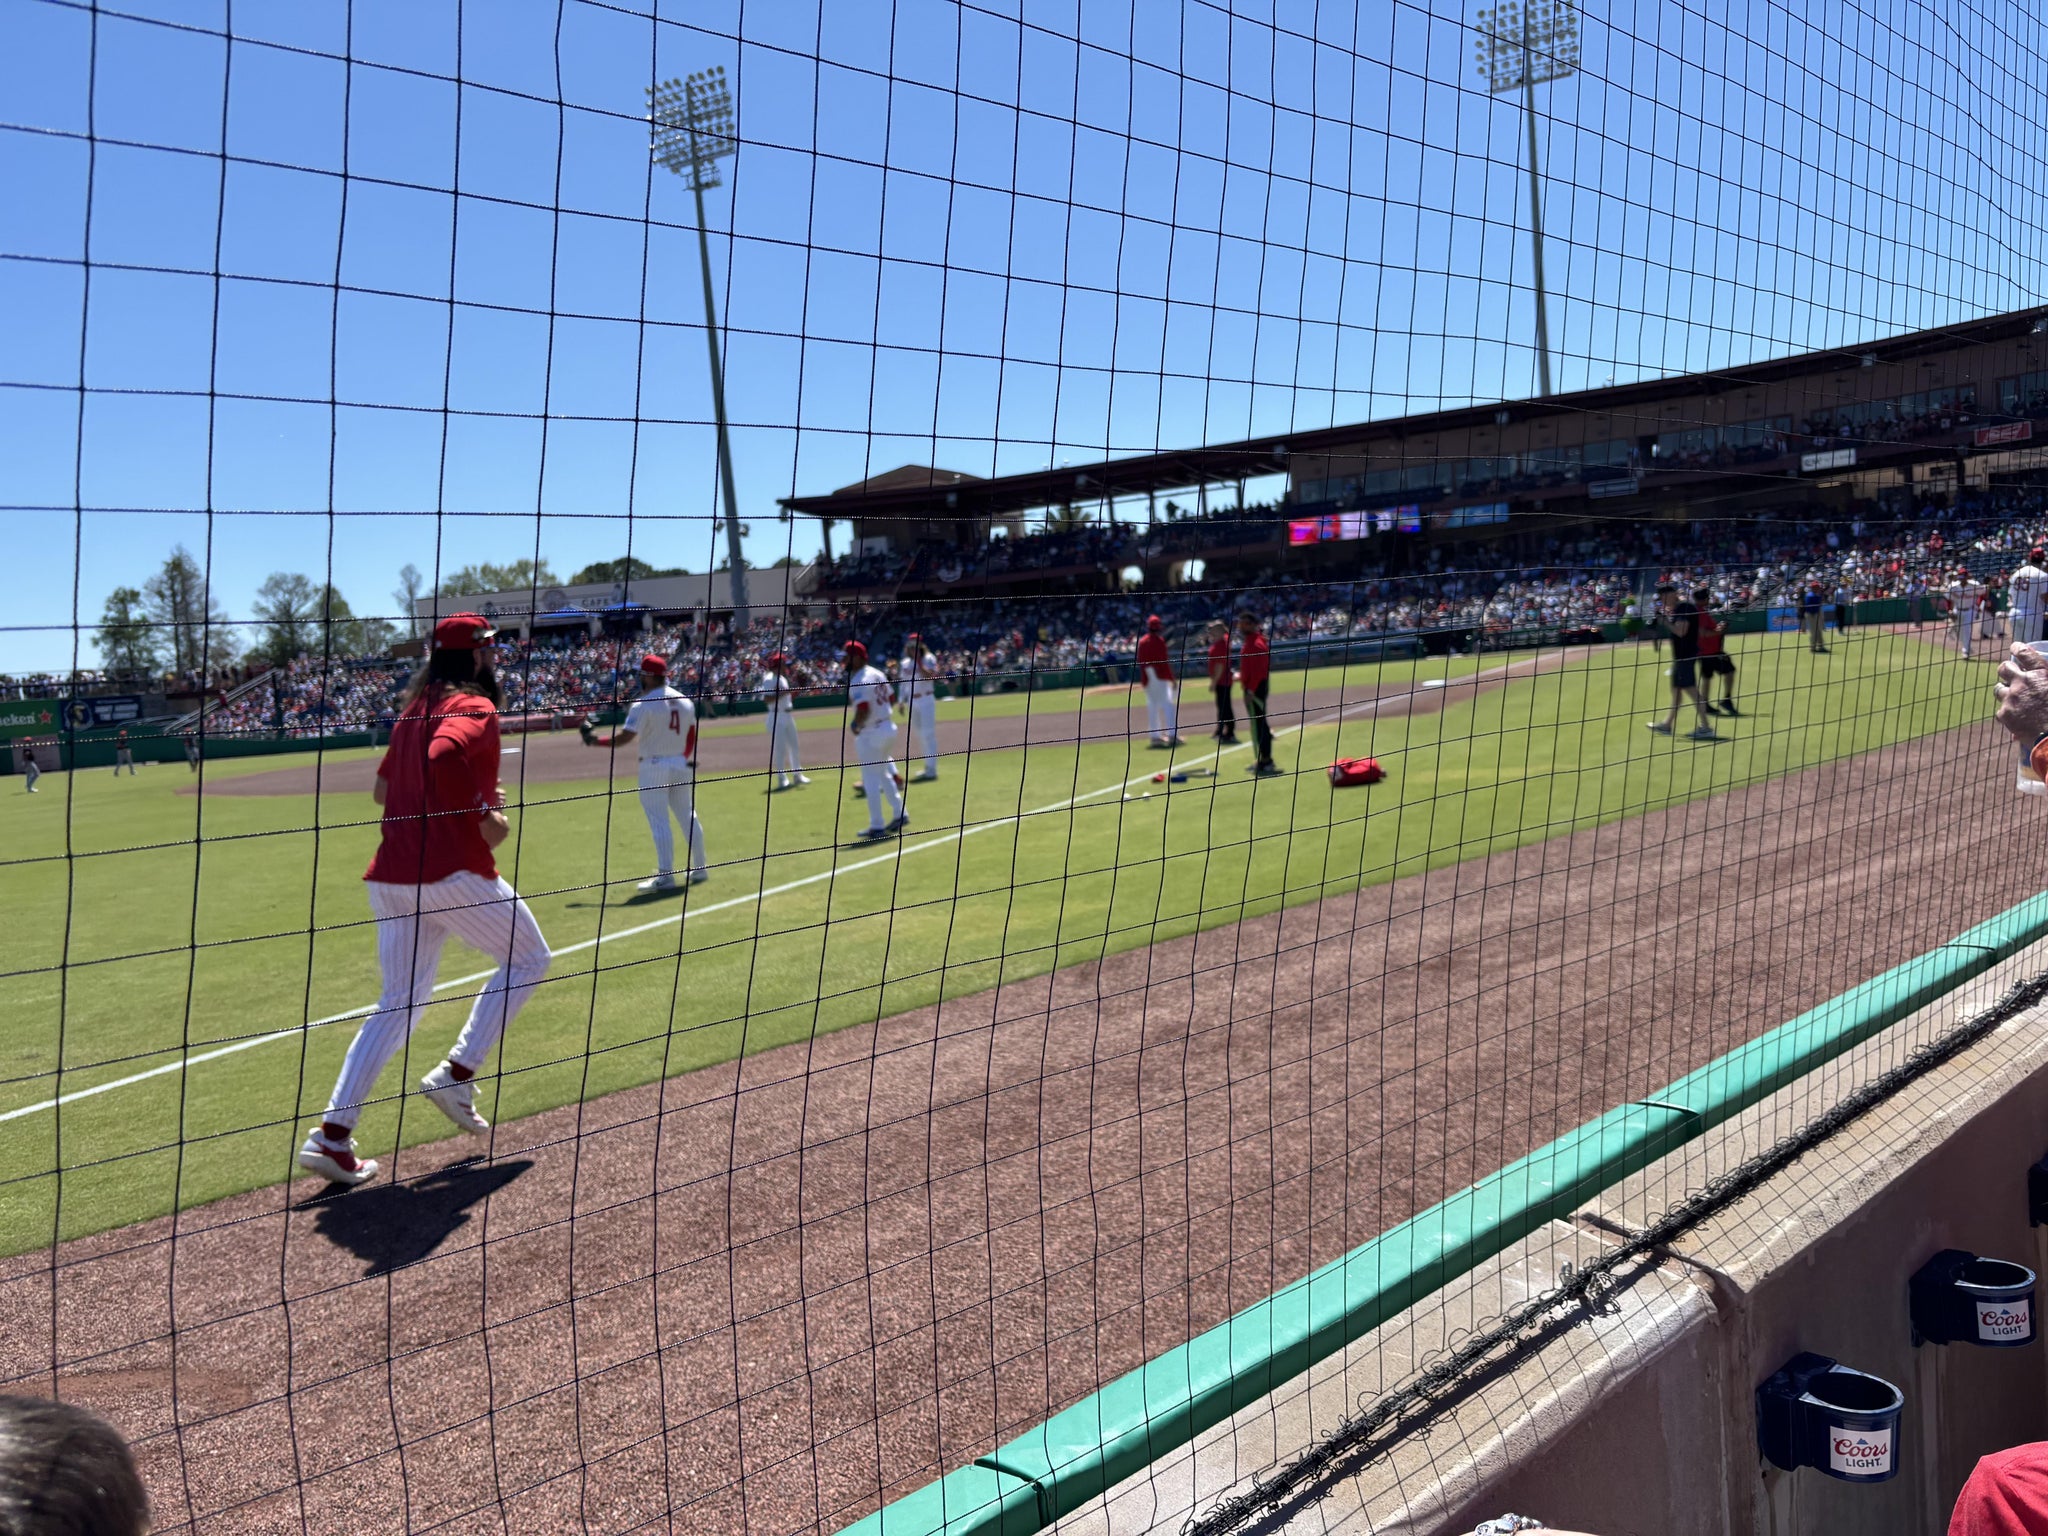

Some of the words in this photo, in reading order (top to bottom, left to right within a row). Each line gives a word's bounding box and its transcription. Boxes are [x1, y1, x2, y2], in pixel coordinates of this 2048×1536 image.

[669, 710, 680, 735] 4
[1981, 1311, 2028, 1326] Coors
[1992, 1325, 2022, 1335] LIGHT
[1833, 1438, 1888, 1457] Coors
[1846, 1457, 1881, 1467] LIGHT
